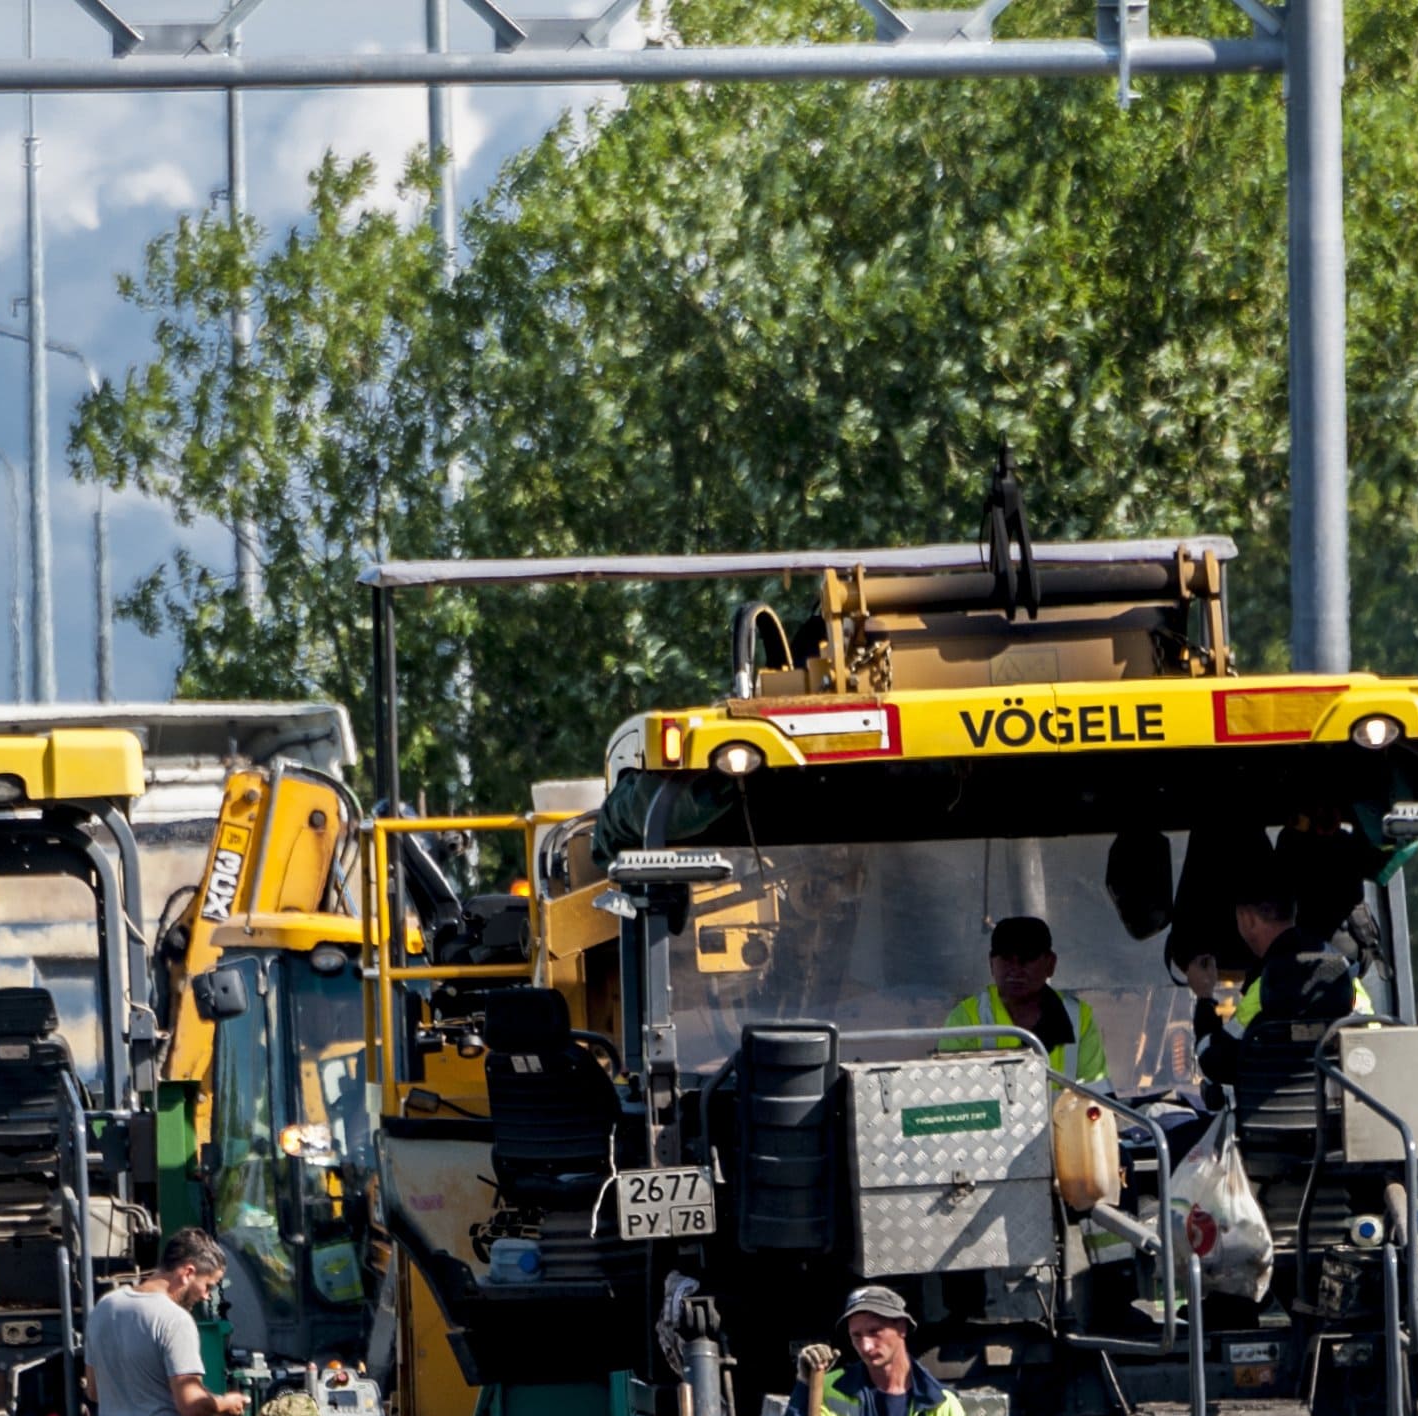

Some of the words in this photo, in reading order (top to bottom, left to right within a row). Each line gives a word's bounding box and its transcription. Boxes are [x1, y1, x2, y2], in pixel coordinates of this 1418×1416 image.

[959, 697, 1166, 748] VÖGELE
[202, 849, 243, 920] 3CX
[629, 1173, 699, 1204] 2677
[678, 1210, 706, 1231] 78
